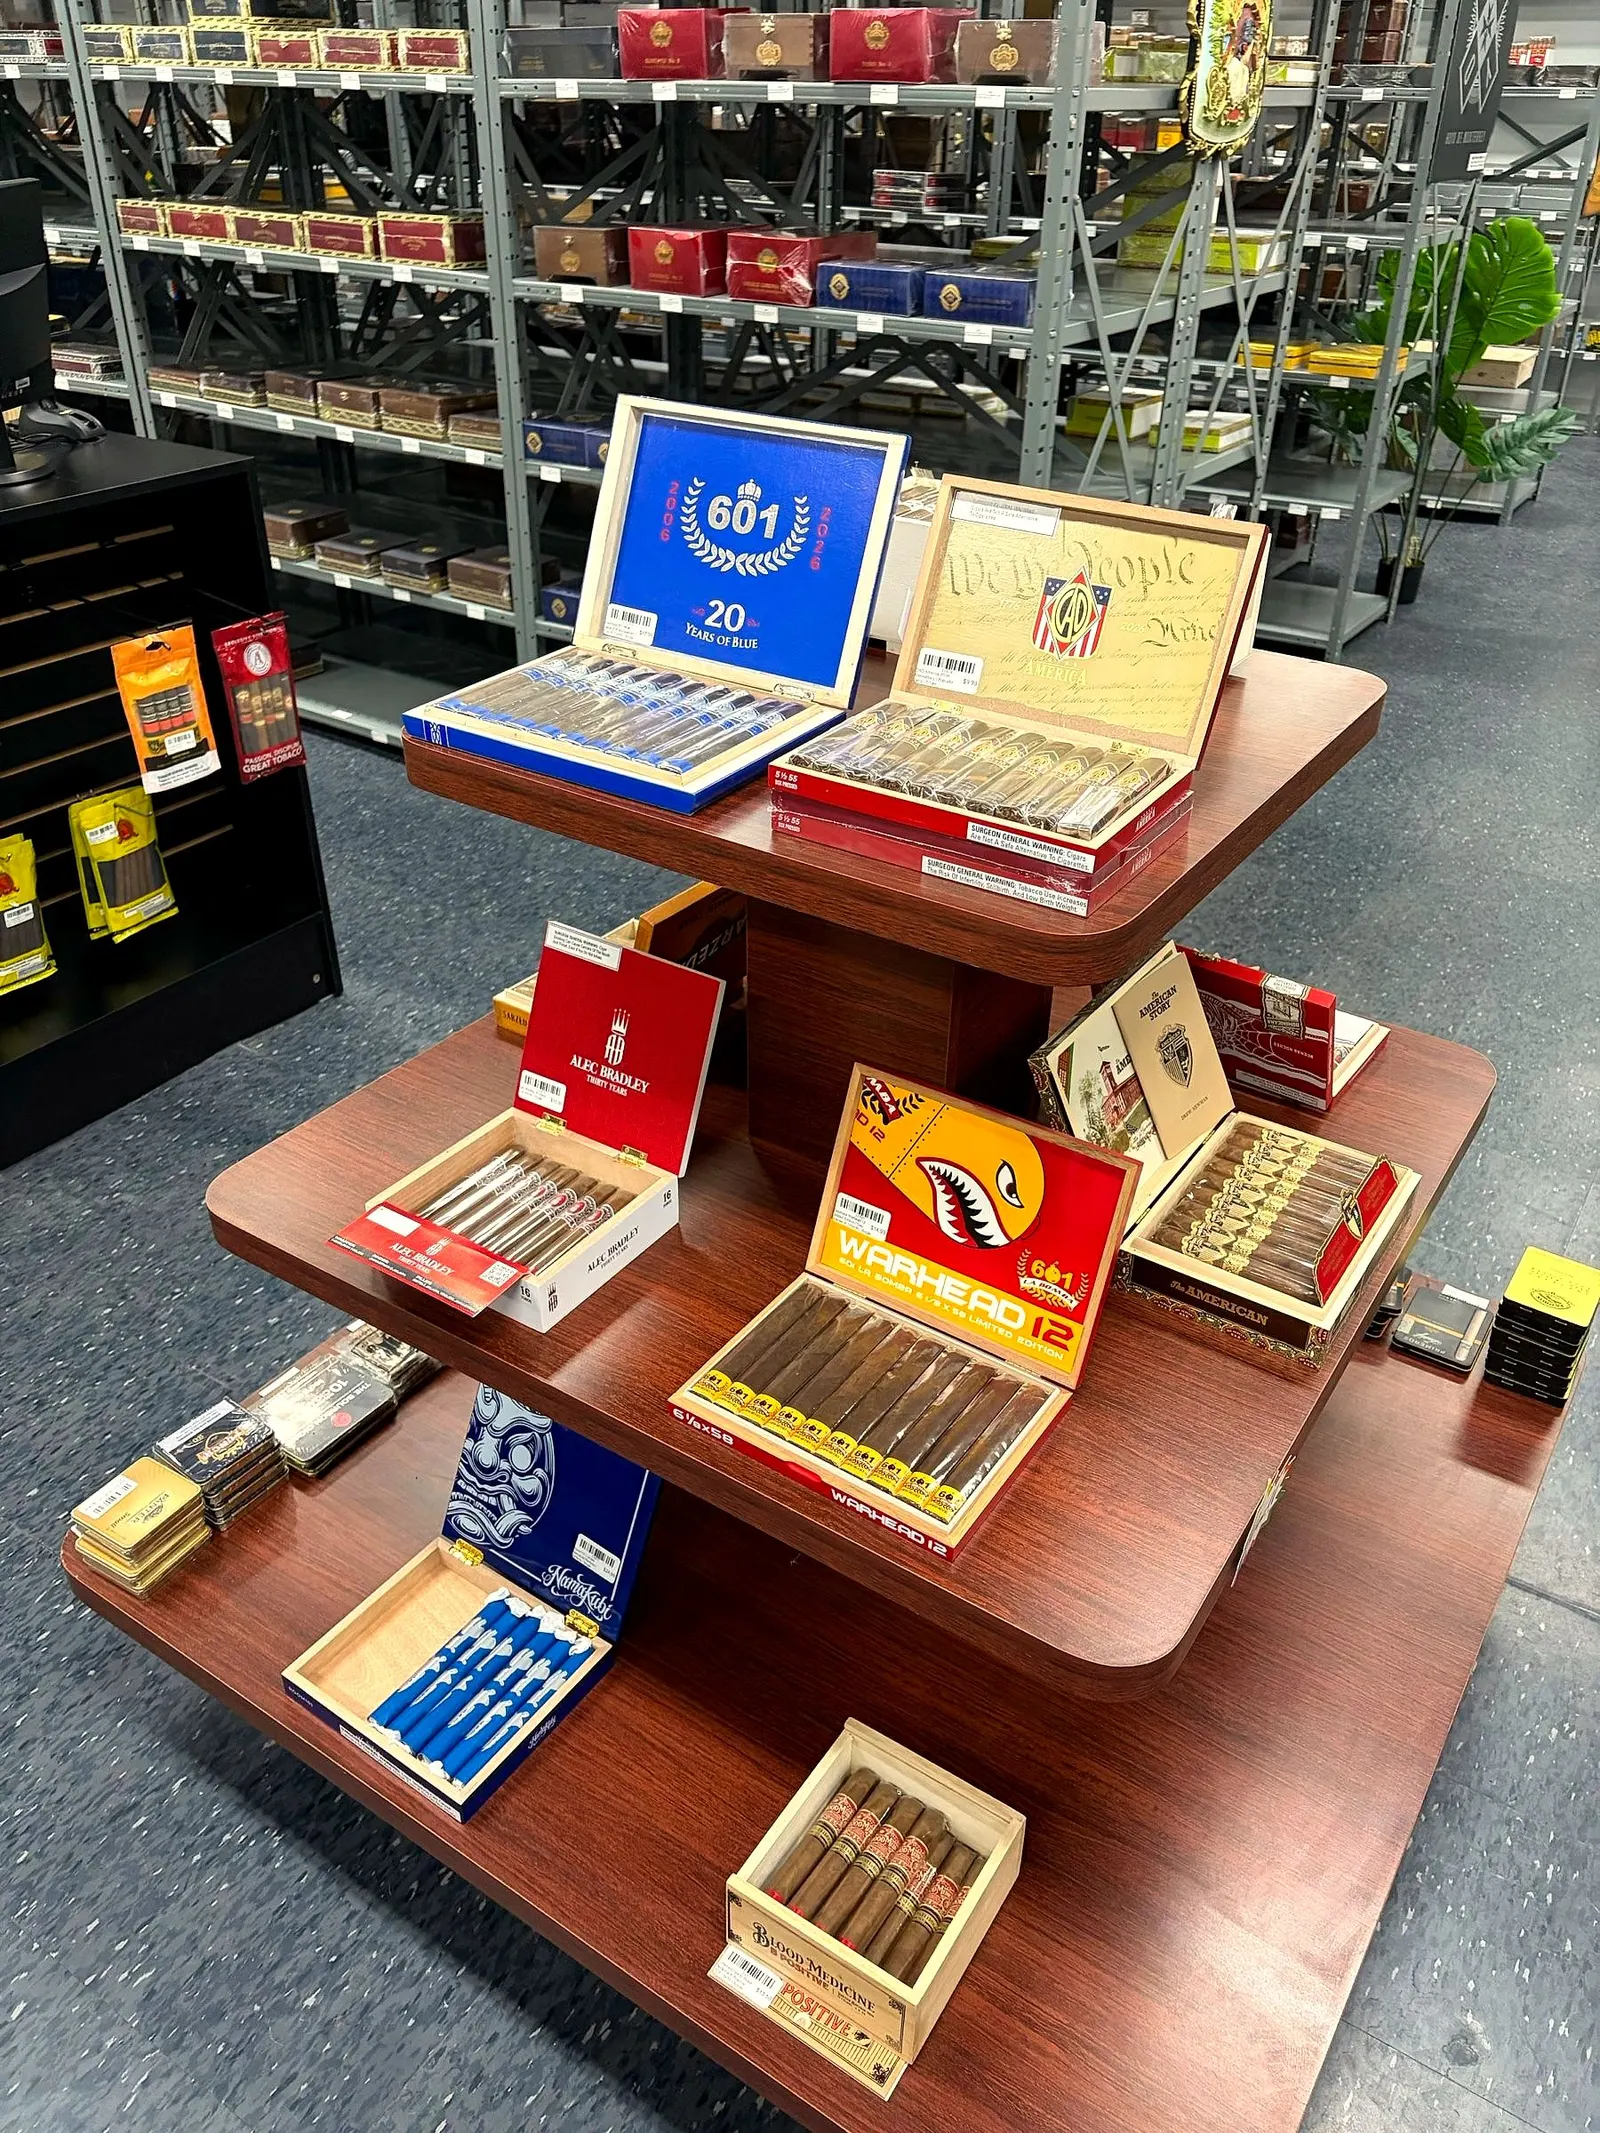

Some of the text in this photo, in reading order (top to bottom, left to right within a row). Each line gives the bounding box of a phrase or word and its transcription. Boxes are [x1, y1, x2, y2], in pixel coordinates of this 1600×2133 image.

[659, 480, 680, 542] 2006
[707, 495, 780, 539] 601
[809, 506, 833, 572] 2026
[704, 599, 746, 632] 20
[1055, 587, 1090, 639] CAO
[685, 622, 759, 649] YEARS OF BLUE
[1025, 661, 1087, 685] AMERICA
[242, 744, 303, 774] GREAT TOBACCO
[788, 773, 799, 783] 55
[790, 817, 801, 825] 55
[970, 832, 981, 841] Are
[982, 835, 994, 844] Not
[994, 838, 1000, 846] A
[1000, 840, 1014, 850] Safe
[1015, 844, 1048, 860] Alternative
[1049, 853, 1057, 862] To
[971, 825, 1087, 862] SURGEON GENERAL WARNING: Cigars
[927, 859, 1087, 909] SURGEON GENERAL WARNING: Tobacco Use Increases
[927, 866, 938, 875] The
[938, 869, 951, 878] Risk
[1012, 889, 1026, 898] And
[1025, 892, 1039, 901] Low
[1039, 896, 1055, 907] Birth
[1139, 985, 1178, 1019] AMERICAN
[1149, 1000, 1172, 1021] STORY
[569, 1054, 650, 1094] ALEC BRADLEY
[1116, 1054, 1132, 1074] AME
[586, 1074, 628, 1097] THIRTY YEARS
[662, 1189, 672, 1203] 16
[389, 1243, 415, 1259] ALEC
[411, 1252, 456, 1276] BRADLEY
[587, 1225, 640, 1274] ALEC BRADLEY
[520, 1285, 531, 1297] 16
[839, 1229, 1076, 1352] WARHEAD 12
[1023, 1278, 1075, 1306] LA BOMBA
[1170, 1280, 1269, 1326] The AMERICAN
[858, 1265, 872, 1277] LA
[874, 1271, 913, 1295] BOMBA
[968, 1313, 1014, 1340] LIMITED
[1016, 1333, 1065, 1361] EDITION
[356, 1382, 372, 1396] THE
[831, 1488, 948, 1558] WARHEAD 12
[752, 1921, 805, 1966] BLOOD
[806, 1957, 876, 2014] MEDICINE
[780, 1955, 830, 1991] POSITIVE
[781, 1982, 852, 2037] POSITIVE
